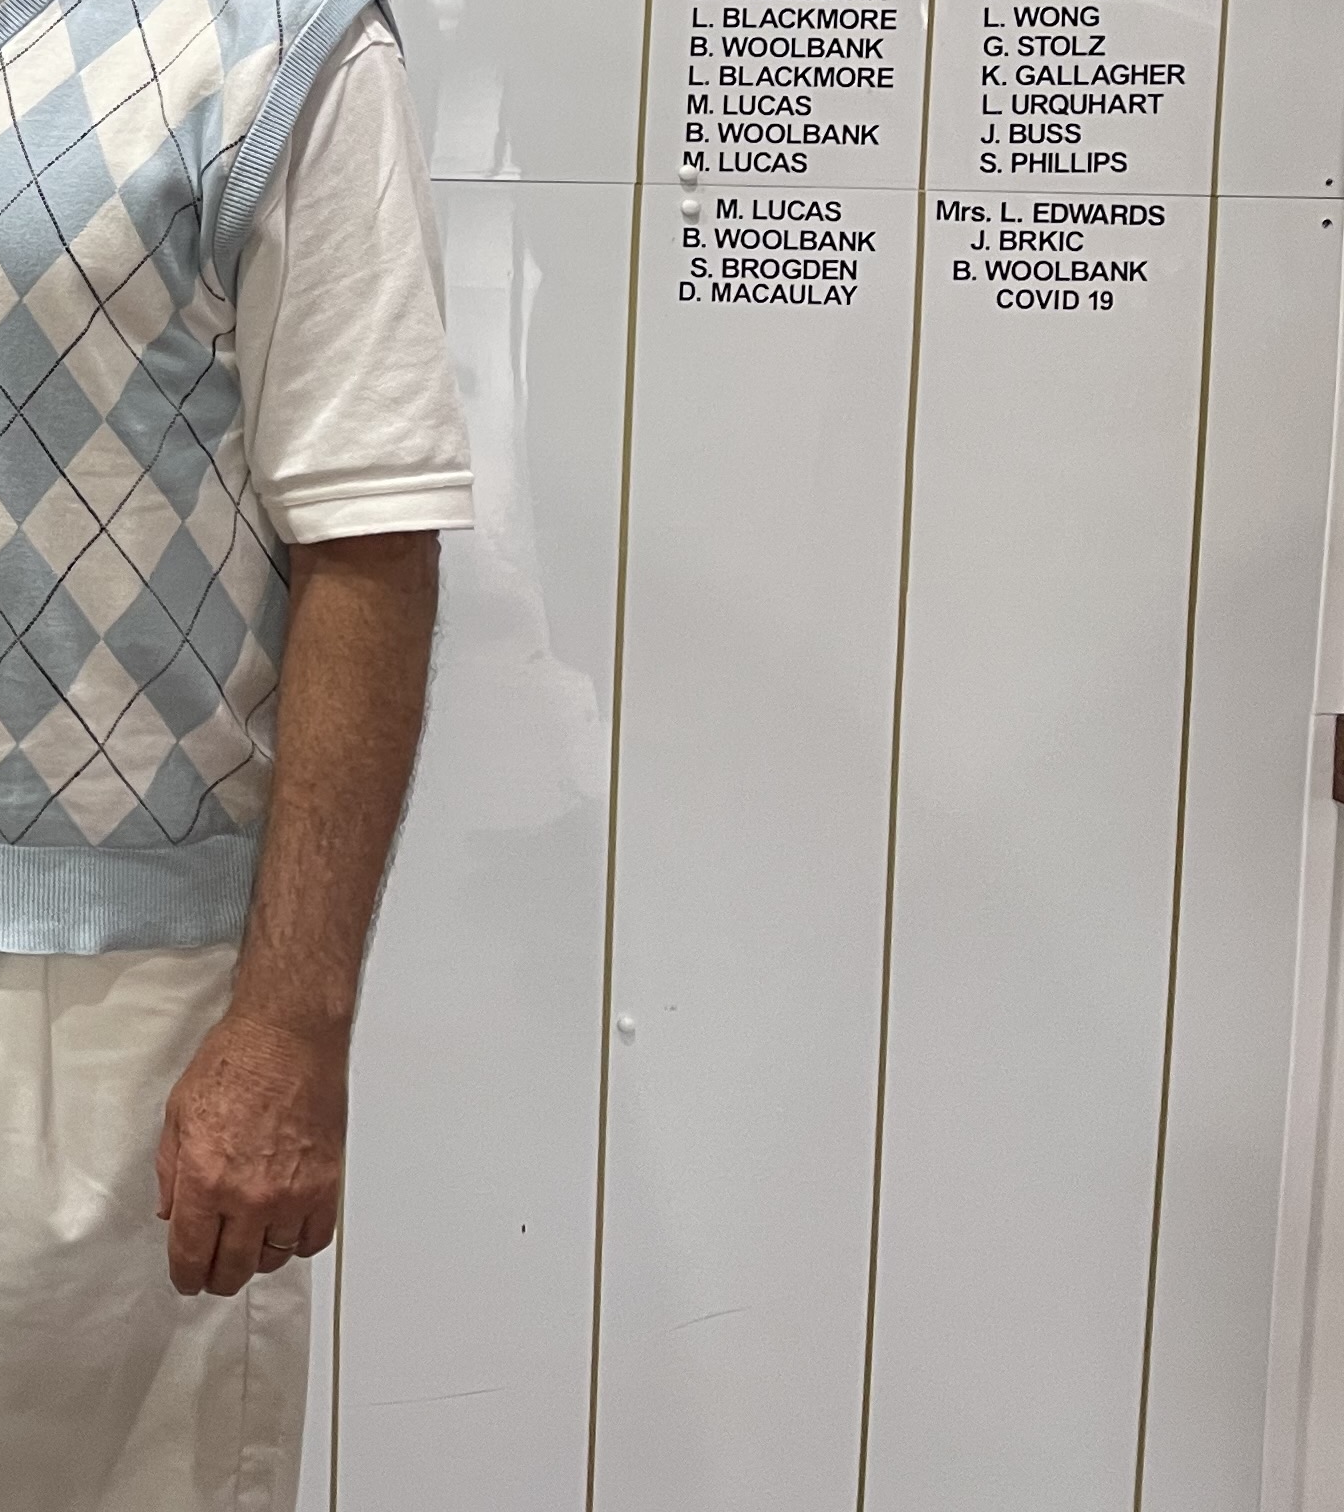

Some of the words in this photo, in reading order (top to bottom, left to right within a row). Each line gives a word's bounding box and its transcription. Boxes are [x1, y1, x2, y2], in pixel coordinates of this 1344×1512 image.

[981, 64, 1007, 86] K.
[1015, 63, 1186, 86] GALLAGHER
[936, 199, 992, 223] Mrs.
[1000, 201, 1023, 224] L.
[1033, 202, 1166, 227] EDWARDS
[678, 281, 702, 302] D.
[711, 281, 858, 306] MACAULAY
